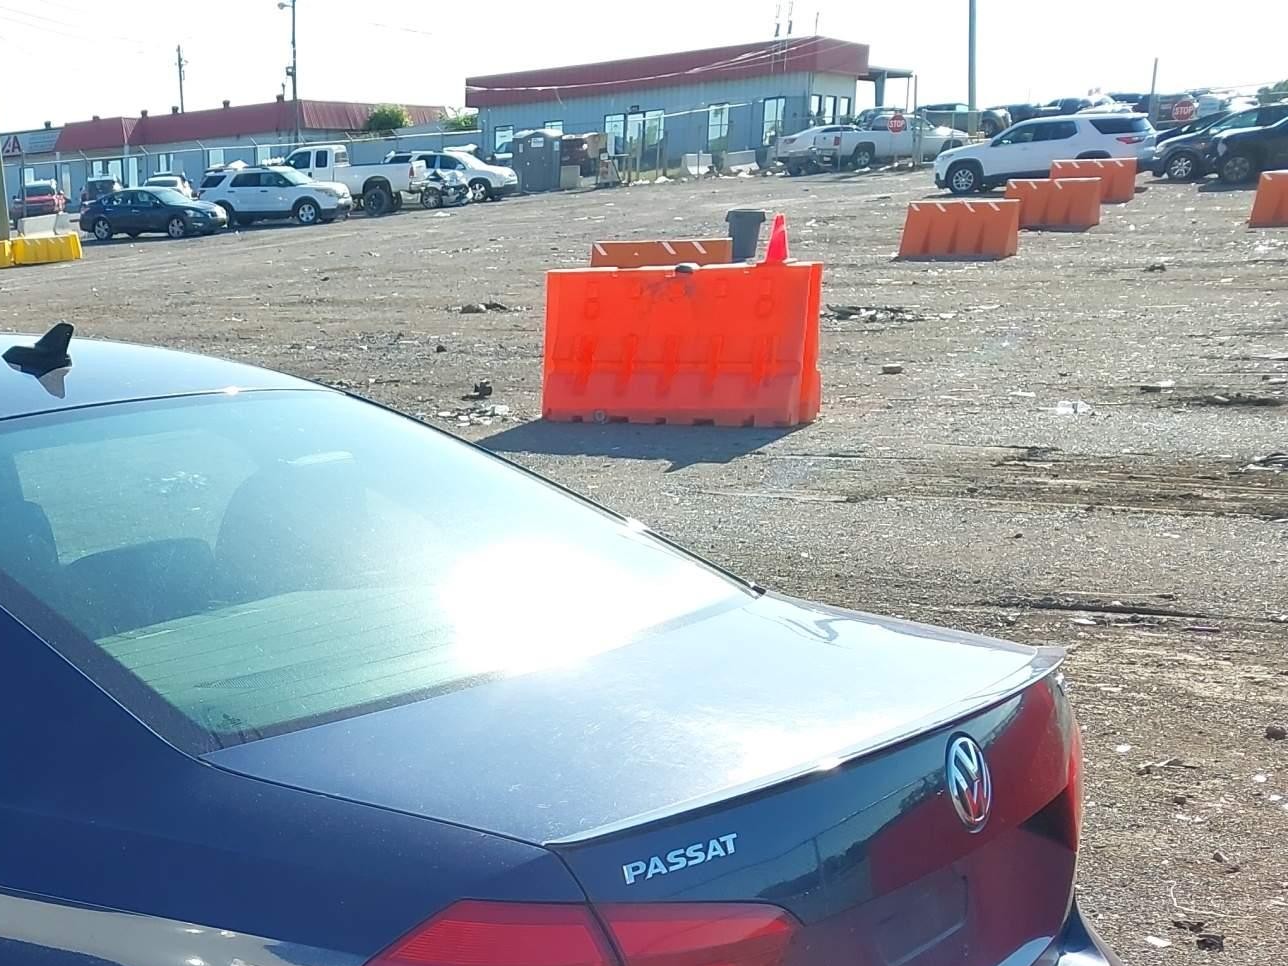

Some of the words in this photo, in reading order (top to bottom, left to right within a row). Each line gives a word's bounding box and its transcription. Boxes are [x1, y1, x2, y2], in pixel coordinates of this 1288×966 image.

[1175, 106, 1194, 115] STOP
[888, 119, 905, 128] STOP
[622, 833, 738, 885] PASSAT
